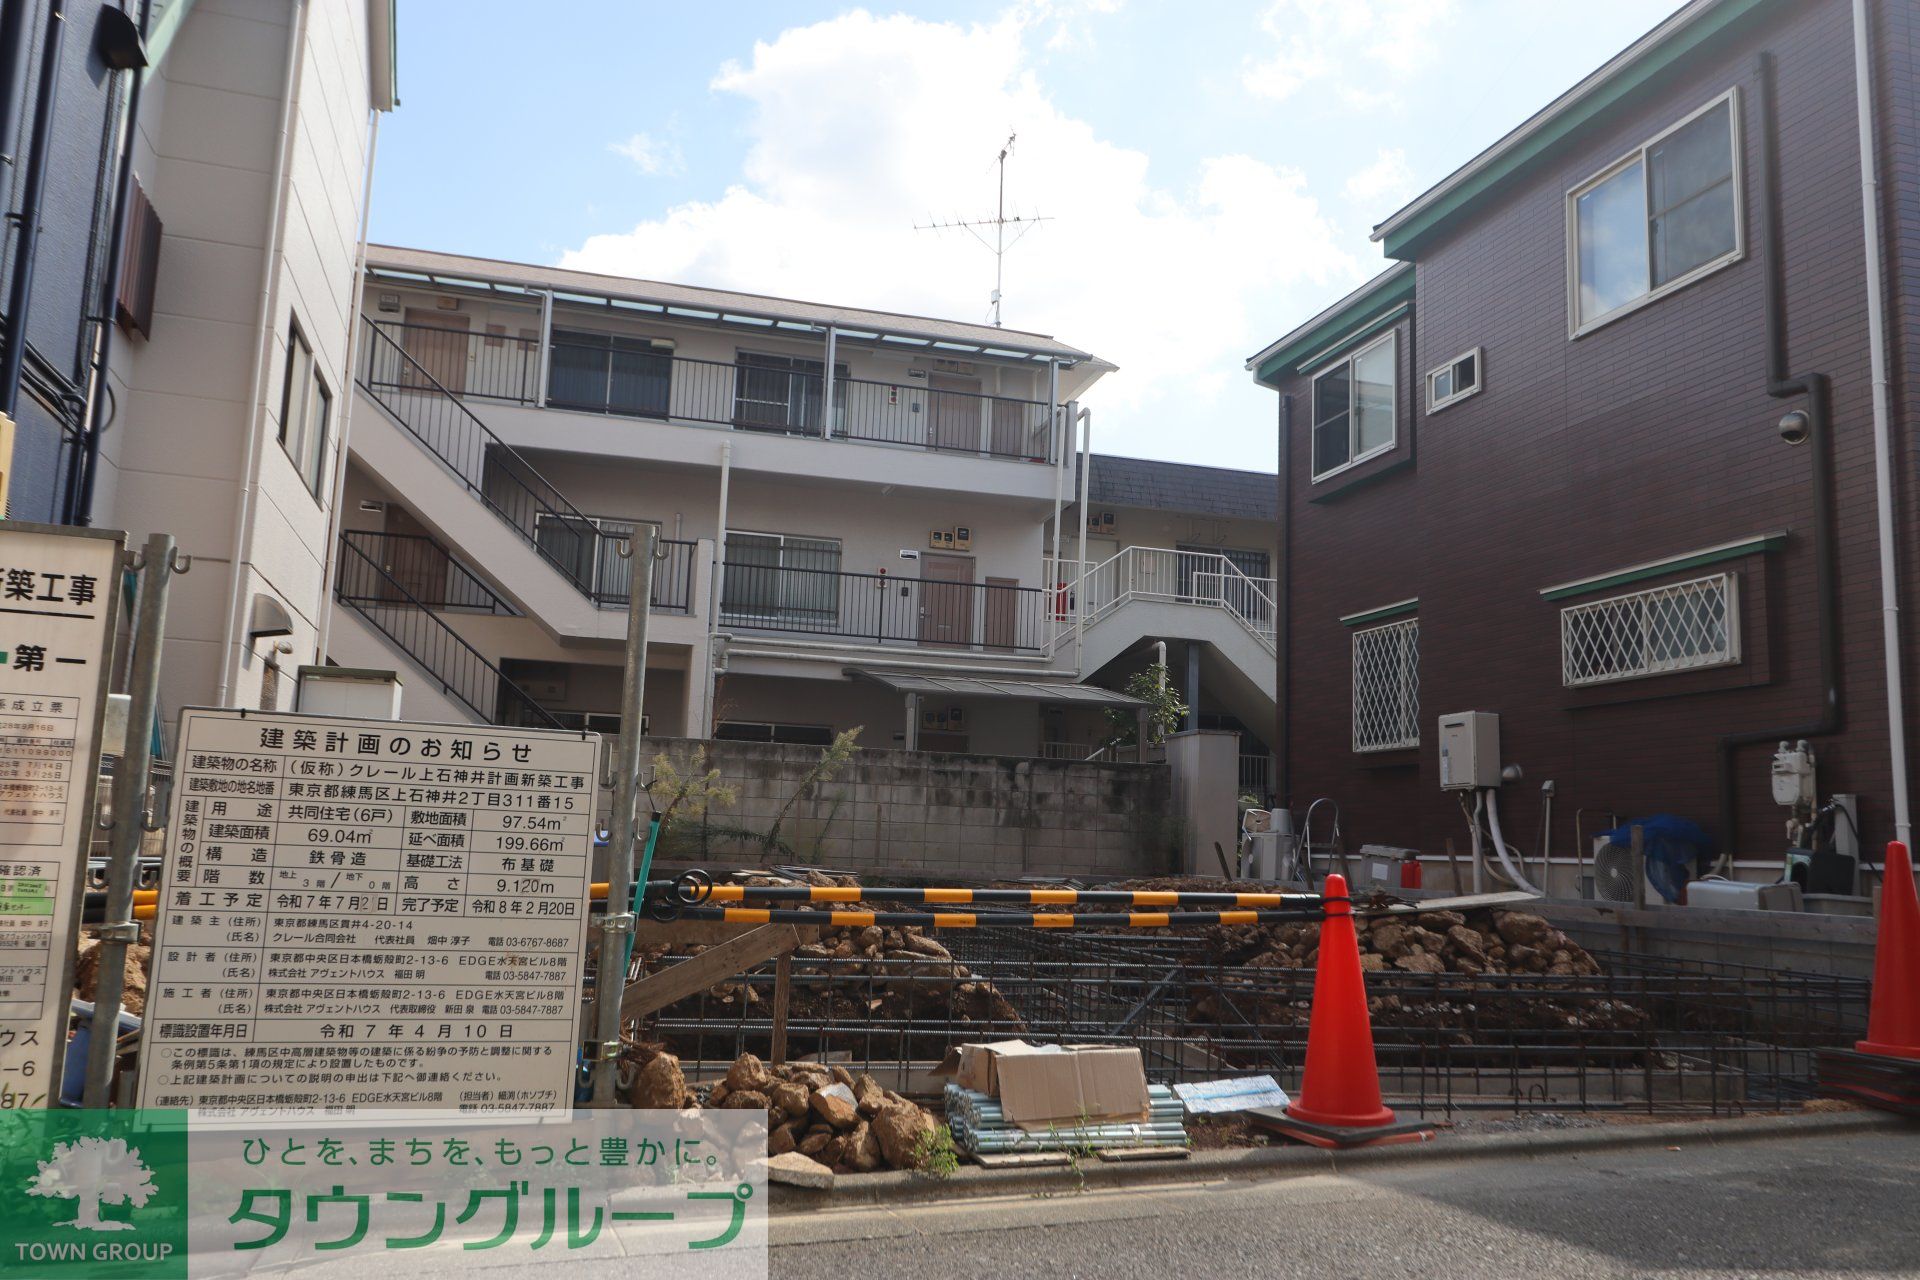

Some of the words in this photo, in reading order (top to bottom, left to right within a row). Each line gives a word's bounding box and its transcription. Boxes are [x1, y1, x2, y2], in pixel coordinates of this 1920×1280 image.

[0, 568, 97, 605] 築工事
[13, 645, 86, 672] 第一
[260, 727, 532, 763] 建築計画のお知らせ
[192, 755, 277, 772] 建築物の名称
[290, 758, 584, 789] （仮称）クレール上石神井計画新築工事
[189, 778, 275, 796] 建築敷地の地名地番
[289, 782, 574, 810] 東京都練馬区上石神井2丁目311番15
[211, 802, 273, 818] 用途
[288, 804, 393, 824] 共同住宅（6戸）
[410, 810, 466, 826] 敷地面積
[209, 824, 270, 840] 建築面積
[409, 832, 465, 848] 延べ面積
[177, 800, 199, 882] 建築物の概要
[206, 846, 268, 863] 構造
[309, 850, 366, 866] 鉄骨造
[406, 853, 463, 869] 基礎工法
[502, 858, 554, 872] 布基礎
[203, 869, 265, 885] 階数
[404, 876, 460, 890] 高さ
[497, 879, 554, 893] 9.120m
[175, 891, 263, 908] 着工予定
[402, 898, 458, 913] 完了予定
[472, 900, 575, 917] 令和8年2月20日
[274, 917, 413, 930] 東京都練馬区貫井4-20-14
[227, 933, 259, 942] （氏名）
[273, 933, 356, 944] クレール合同会社
[375, 936, 415, 945] 代表社員
[488, 937, 504, 946] 電話
[506, 938, 568, 947] 03-6767-8687
[459, 956, 567, 967] EDGE水天宮ビル8階
[223, 968, 255, 978] （氏名）
[268, 968, 305, 978] 株式会社
[485, 970, 500, 980] 電話
[504, 971, 566, 981] 03-5847-7887
[456, 990, 564, 1001] EDGE水天宮ビル8階
[218, 1004, 251, 1014] （氏名）
[264, 1004, 302, 1014] 株式会社
[390, 1005, 436, 1014] 代表取締役
[482, 1005, 497, 1015] 電話
[501, 1005, 563, 1015] 03-5847-7887
[159, 1024, 247, 1038] 標識設置年月日
